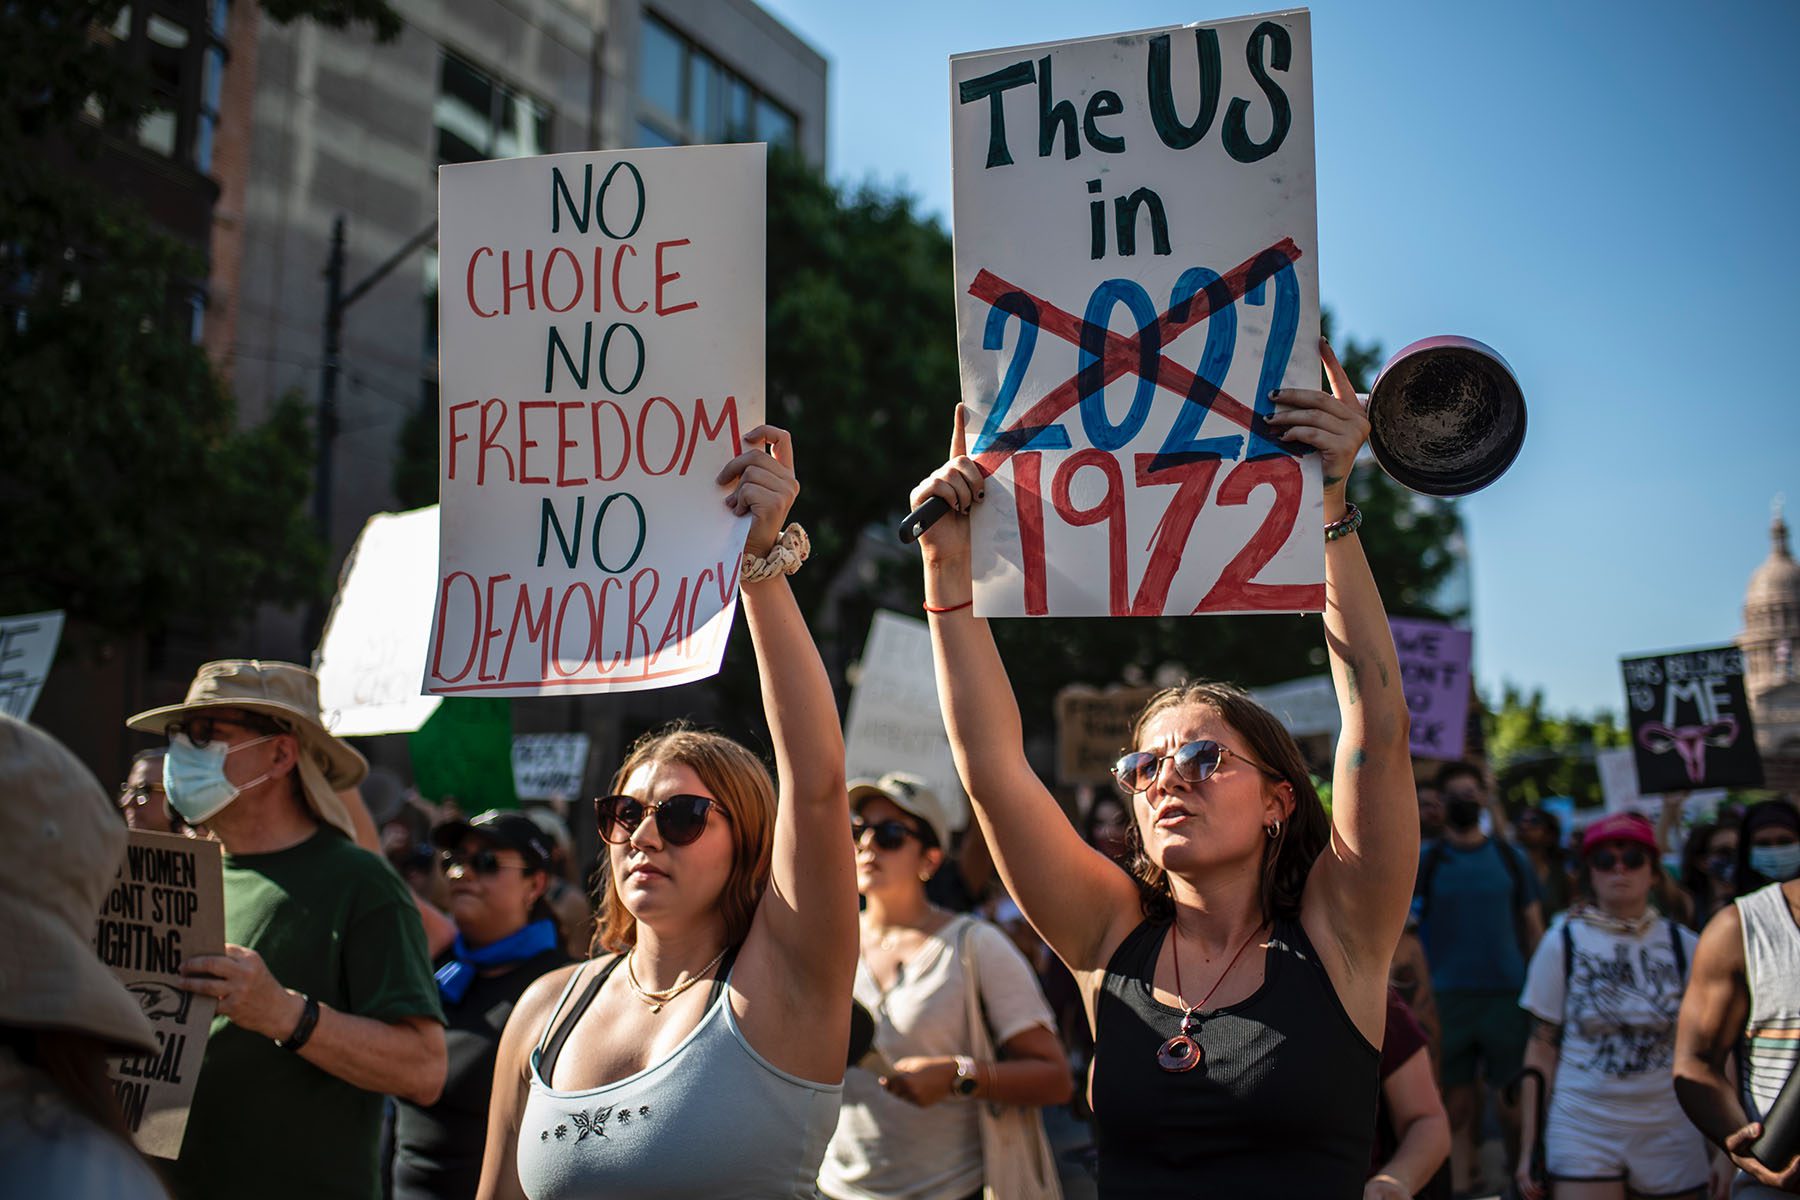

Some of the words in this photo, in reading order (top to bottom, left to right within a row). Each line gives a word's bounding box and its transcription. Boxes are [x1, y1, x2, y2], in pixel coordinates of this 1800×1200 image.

[959, 54, 1126, 169] The
[1147, 21, 1292, 164] US
[551, 161, 645, 239] NO
[1085, 178, 1172, 261] in
[466, 238, 698, 317] CHOICE
[544, 321, 645, 394] NO
[971, 248, 1317, 472] 2022
[448, 396, 742, 488] FREEDOM
[537, 492, 646, 574] NO
[1012, 448, 1326, 616] 1972
[0, 624, 41, 680] E
[431, 551, 742, 682] DEMOCRACY
[1663, 677, 1735, 729] ME
[127, 845, 195, 889] WOMEN
[94, 919, 182, 974] IGHTING
[151, 886, 198, 928] STOP
